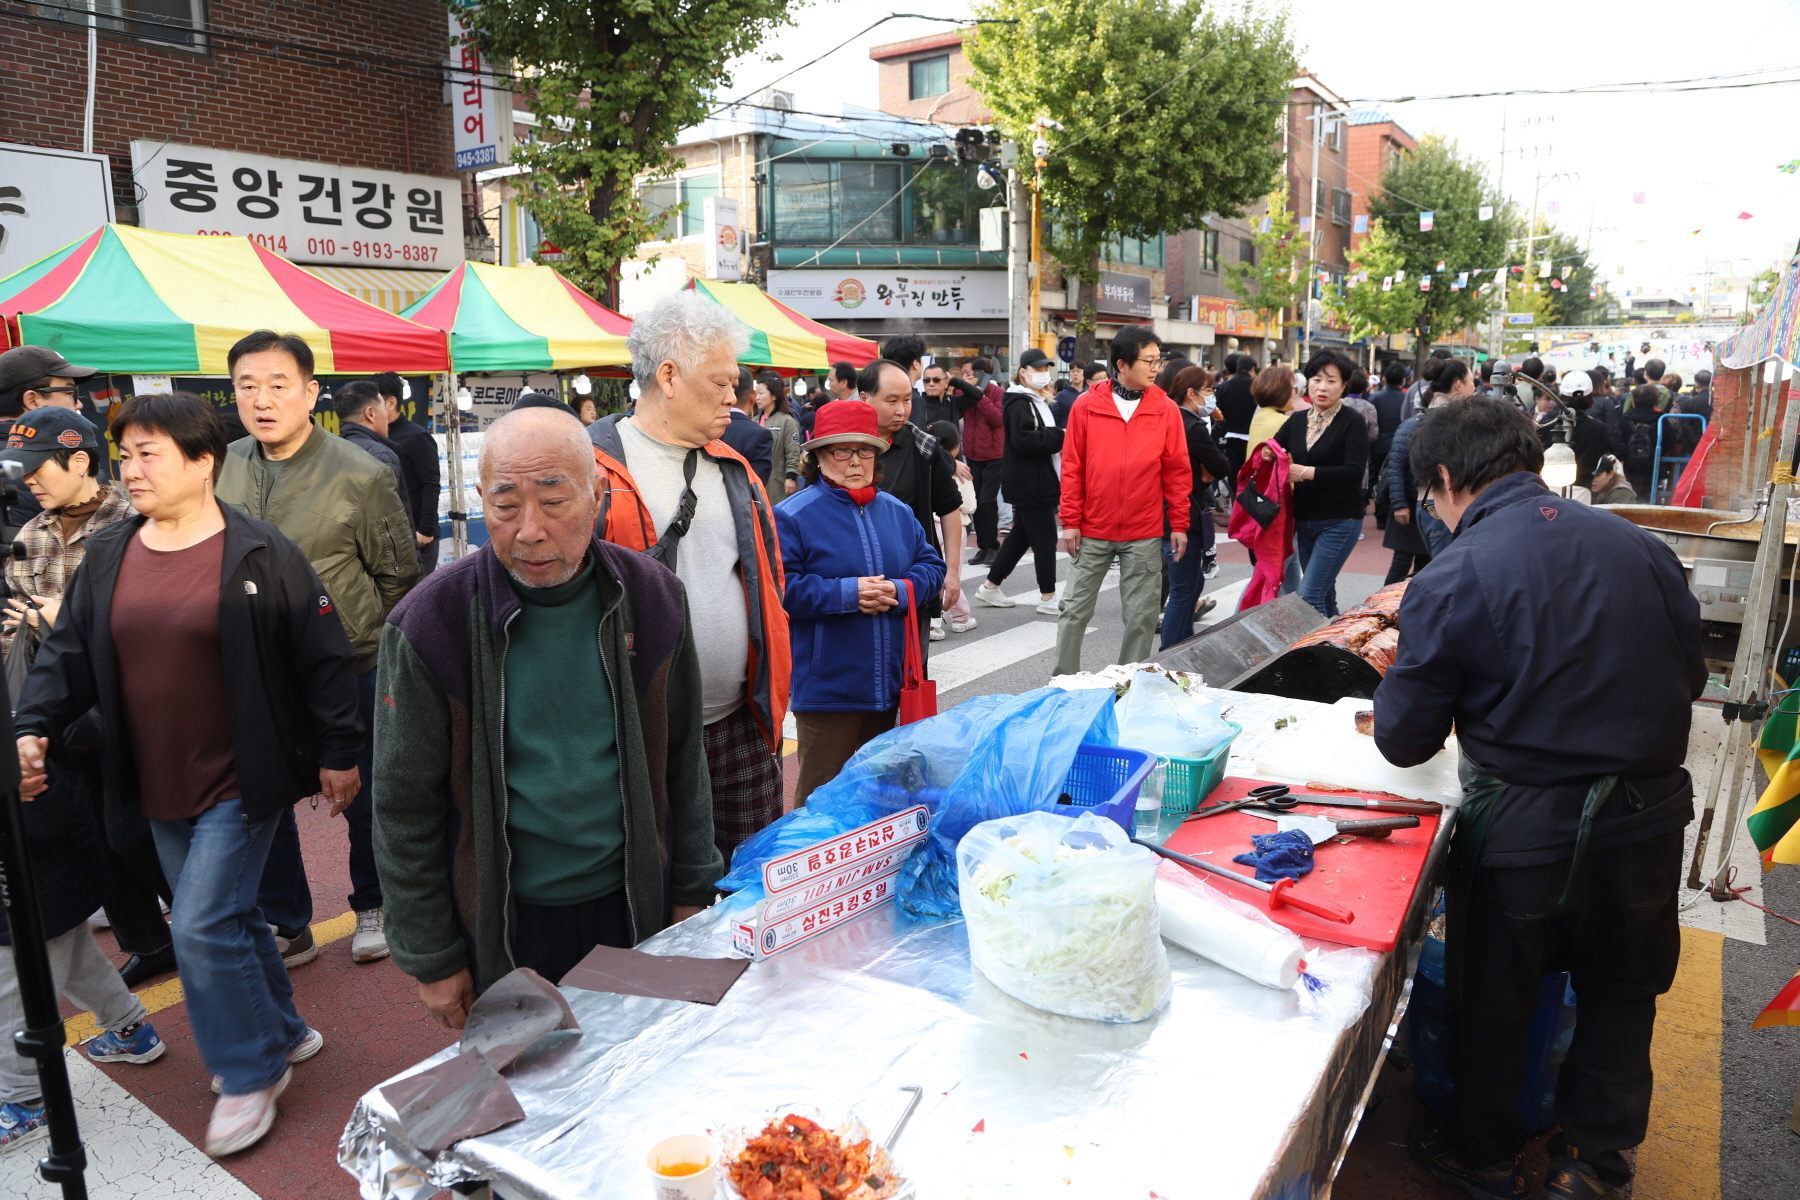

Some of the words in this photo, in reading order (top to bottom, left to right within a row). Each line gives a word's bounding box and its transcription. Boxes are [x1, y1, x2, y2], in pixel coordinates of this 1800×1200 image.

[457, 147, 496, 168] 945-3387
[165, 158, 444, 235] 중앙건강원
[931, 286, 965, 311] 만두
[1104, 284, 1135, 303] 부자부동산
[808, 825, 895, 872] 삼진쿠킹호일
[777, 862, 799, 876] 30m
[861, 855, 893, 877] SAM
[804, 880, 833, 901] FOIL
[835, 870, 861, 891] JIN
[802, 882, 887, 932] 삼진쿠킹호일
